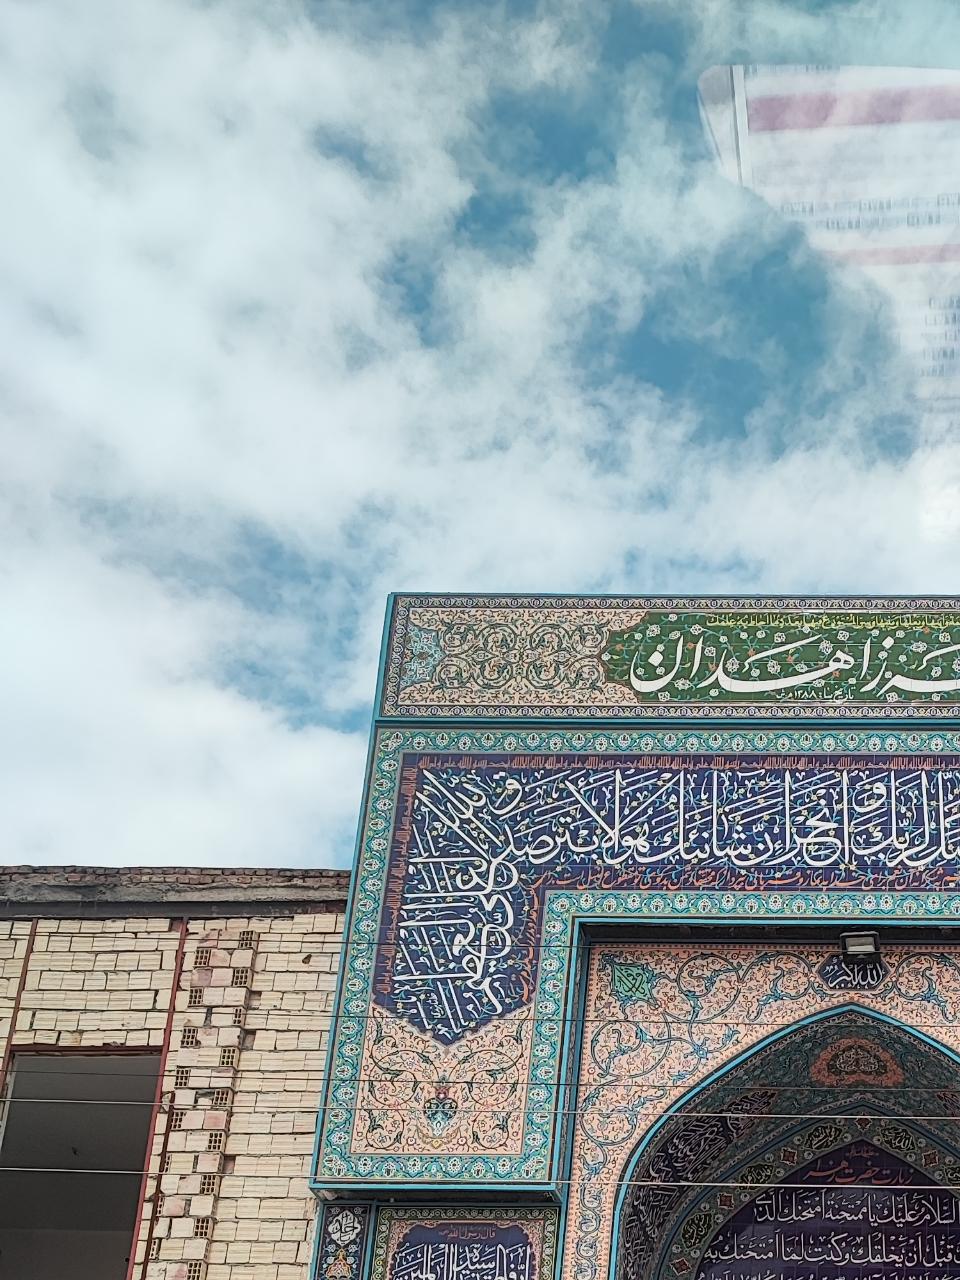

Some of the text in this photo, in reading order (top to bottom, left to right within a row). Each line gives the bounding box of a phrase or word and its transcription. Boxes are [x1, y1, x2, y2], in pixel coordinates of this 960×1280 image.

[860, 963, 883, 988] الله
[876, 1193, 918, 1227] عليك
[703, 1238, 720, 1264] به
[781, 1233, 805, 1265] لما
[804, 1233, 850, 1266] وكنت
[851, 1233, 904, 1267] يخلقك
[905, 1232, 924, 1267] ان
[923, 1235, 954, 1267] قبل
